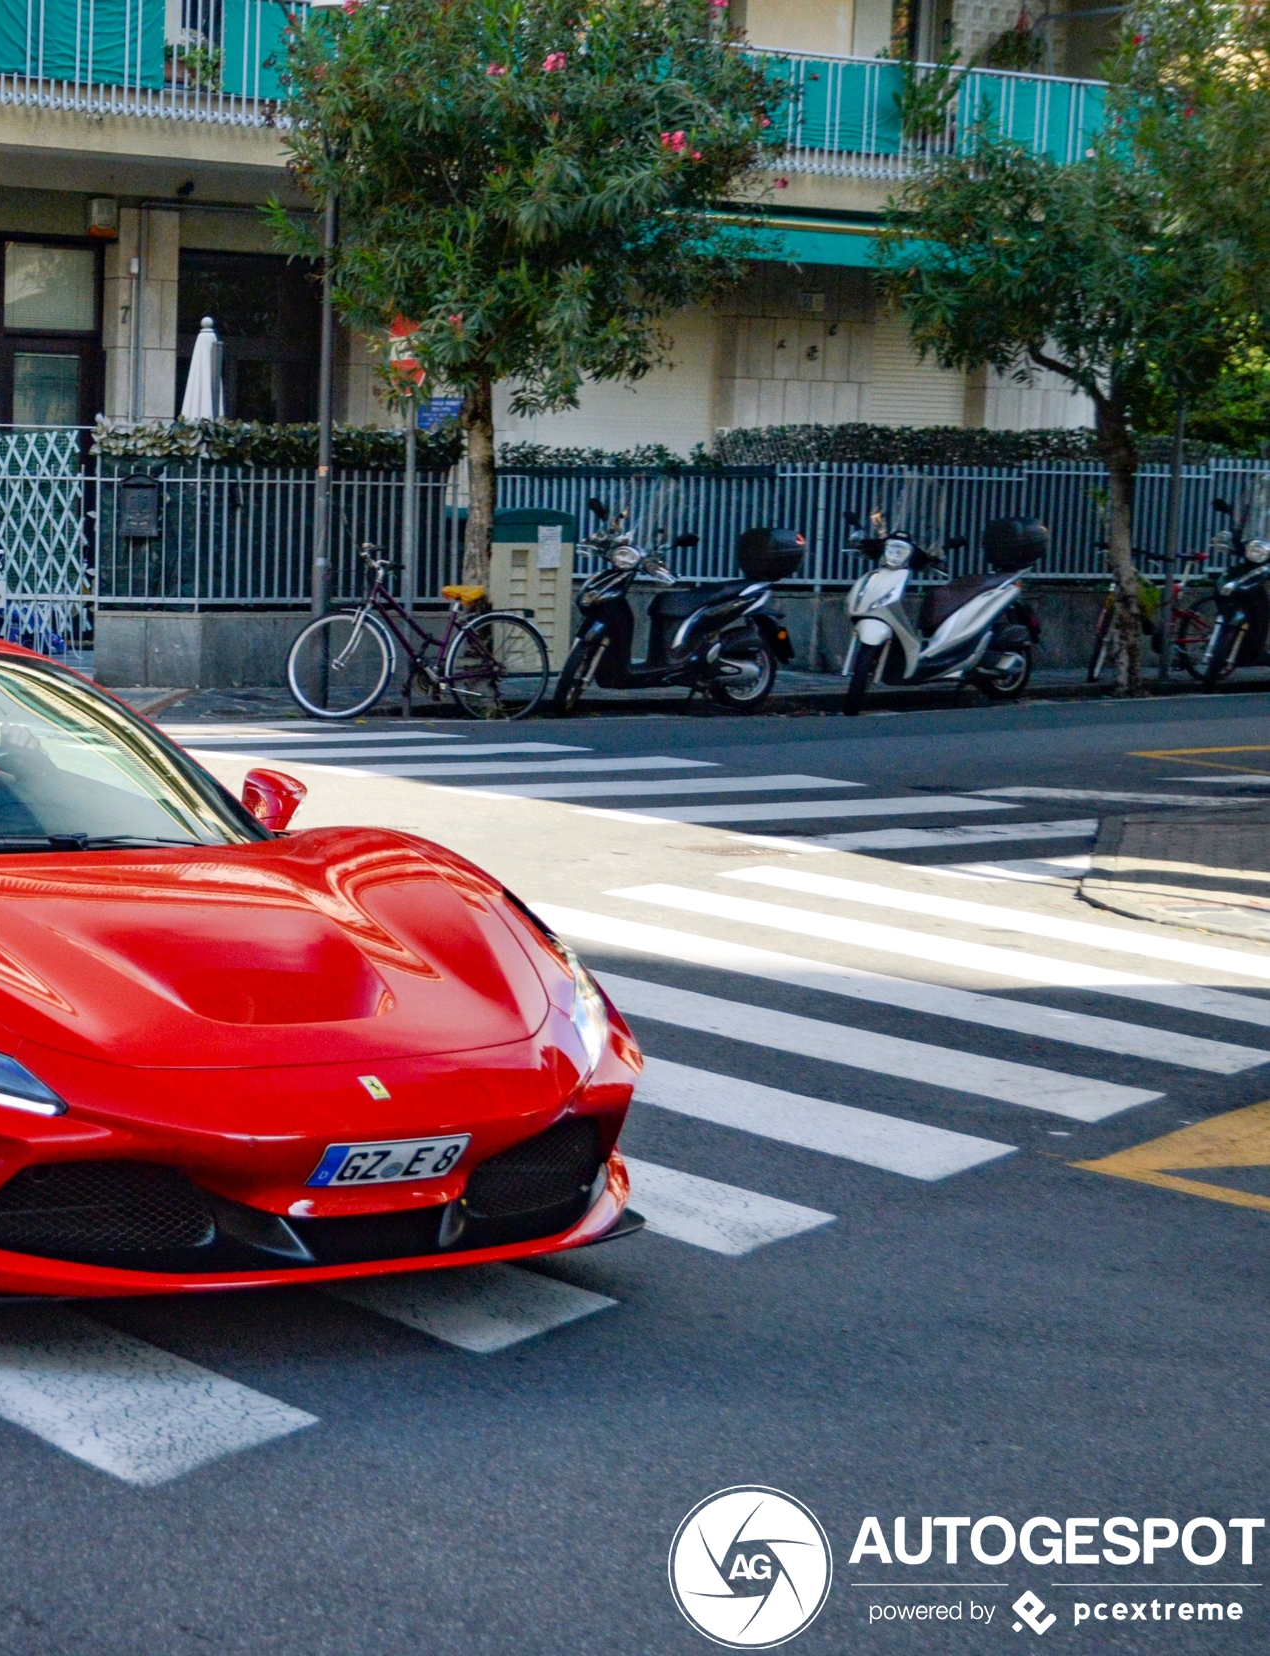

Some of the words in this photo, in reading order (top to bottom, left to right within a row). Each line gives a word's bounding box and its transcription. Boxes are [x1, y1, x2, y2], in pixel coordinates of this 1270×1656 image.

[120, 305, 132, 324] 7
[318, 1170, 329, 1180] D
[336, 1150, 392, 1182] GZ
